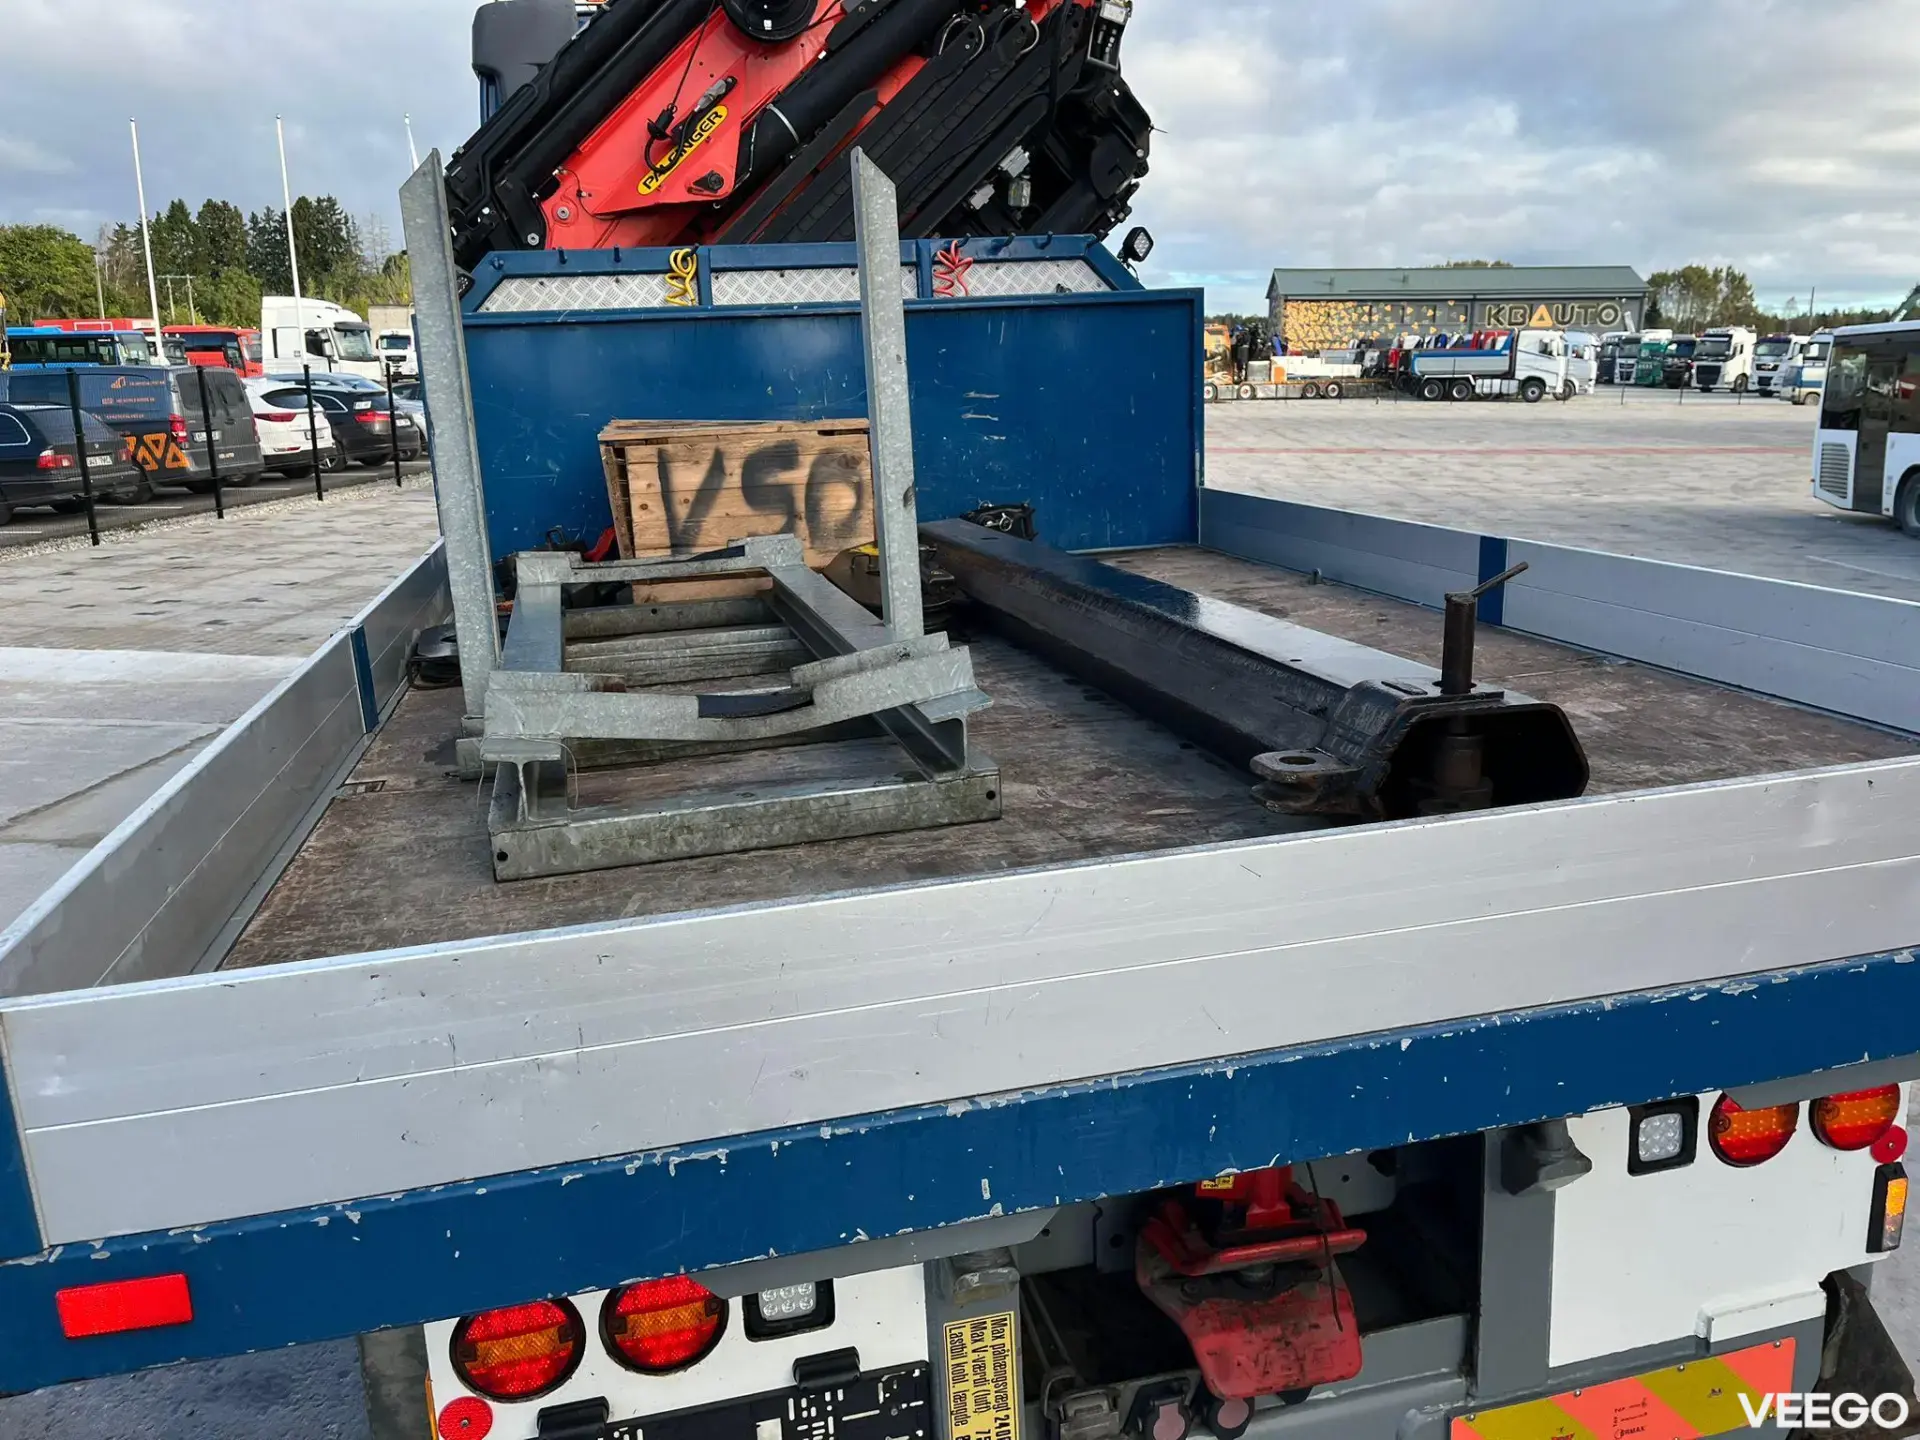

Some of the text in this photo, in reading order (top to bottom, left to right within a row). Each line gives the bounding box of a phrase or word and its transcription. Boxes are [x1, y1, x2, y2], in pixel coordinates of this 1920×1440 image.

[949, 1325, 968, 1360] Lastbil
[970, 1320, 988, 1345] Max
[991, 1317, 1008, 1341] Max
[971, 1345, 991, 1388] V-værdi
[989, 1342, 1011, 1413] påhængsvægt
[951, 1389, 971, 1426] længde
[972, 1389, 992, 1414] (luft)
